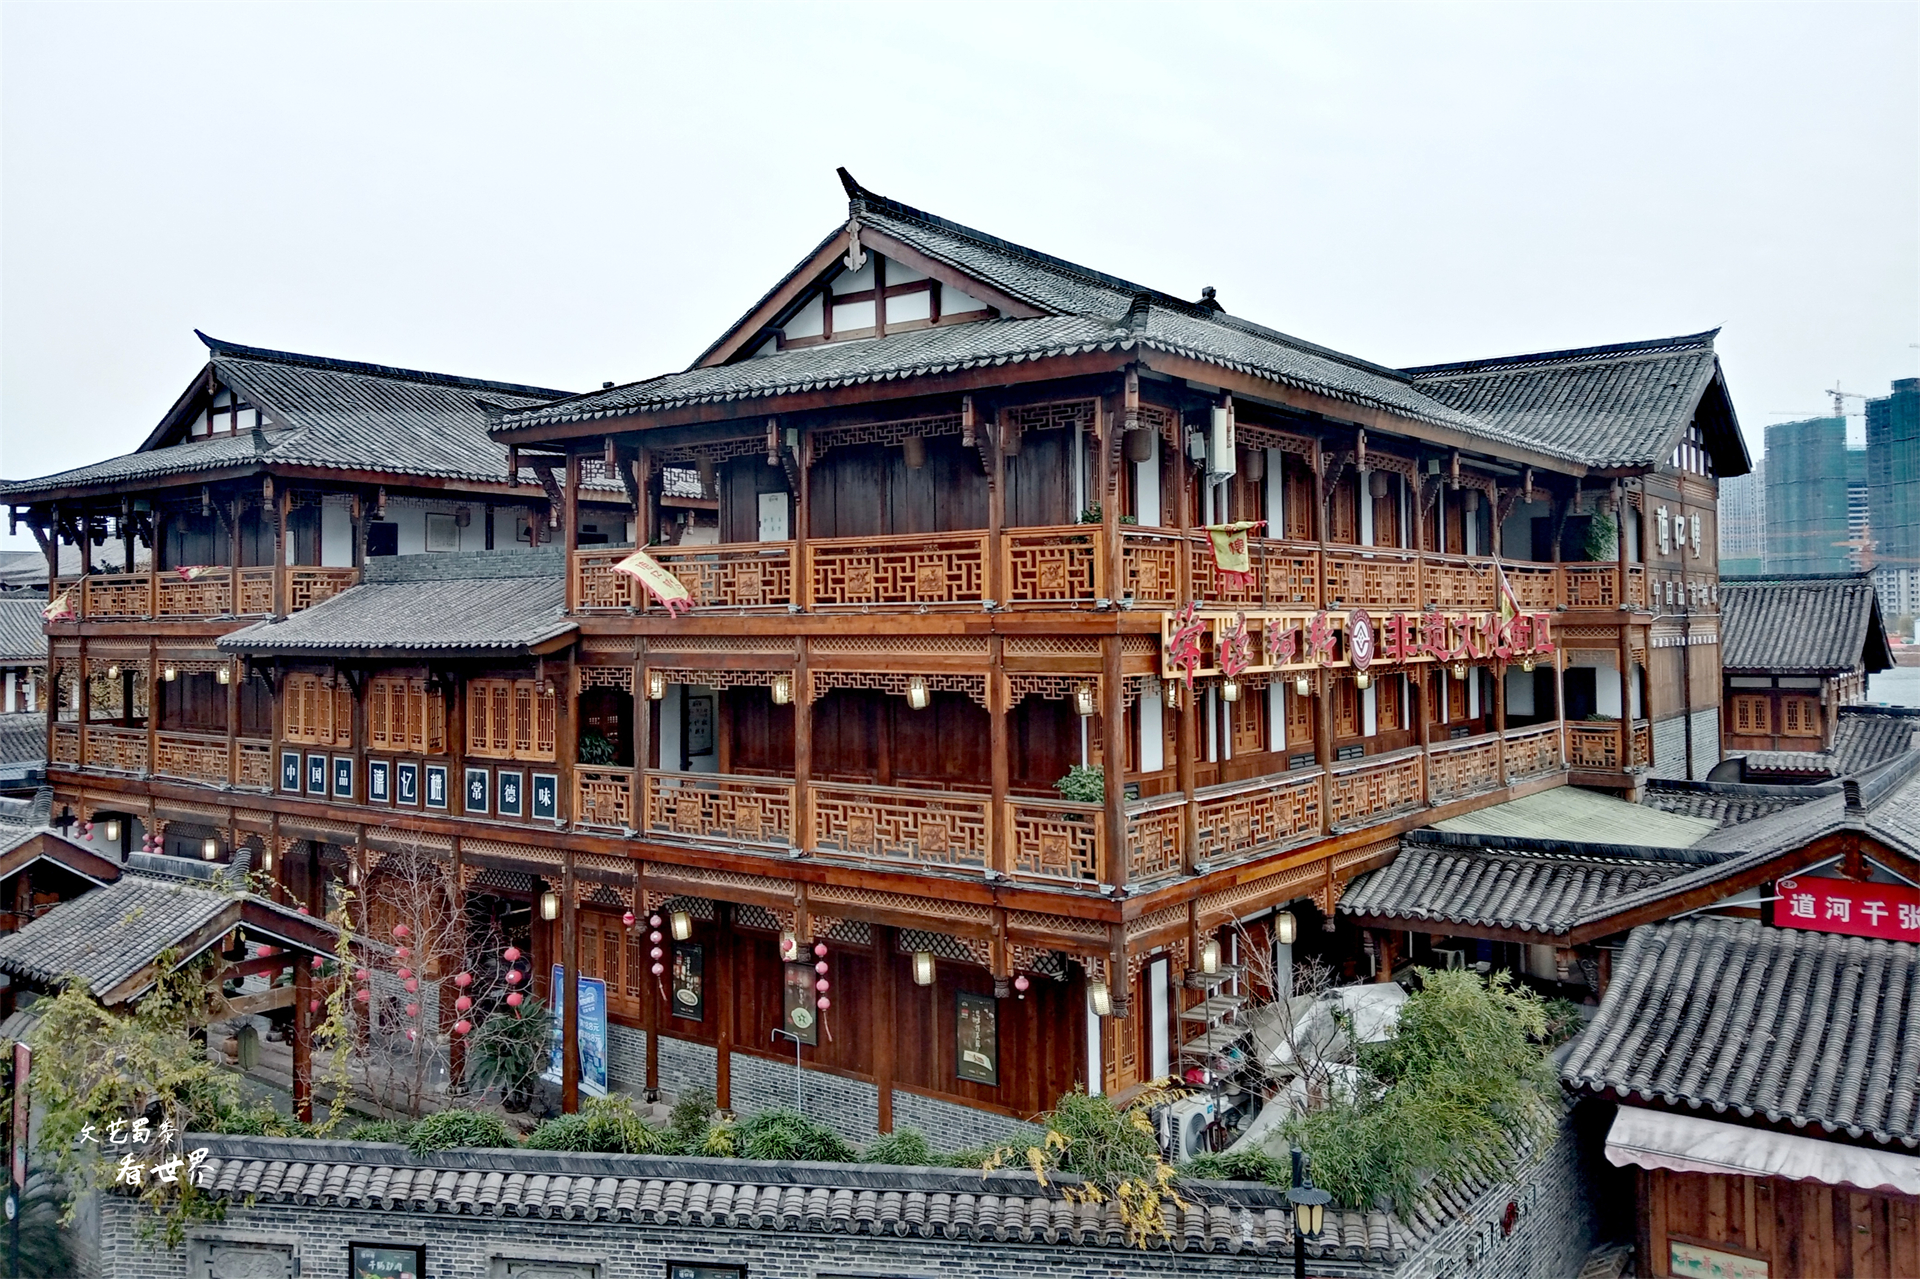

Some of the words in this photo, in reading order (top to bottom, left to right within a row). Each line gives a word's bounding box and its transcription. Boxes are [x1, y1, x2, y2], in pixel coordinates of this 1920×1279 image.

[1385, 611, 1555, 664] 非遗文化街区
[286, 763, 348, 787] 中国品
[471, 781, 551, 807] 常德味
[1789, 893, 1920, 930] 道河千张
